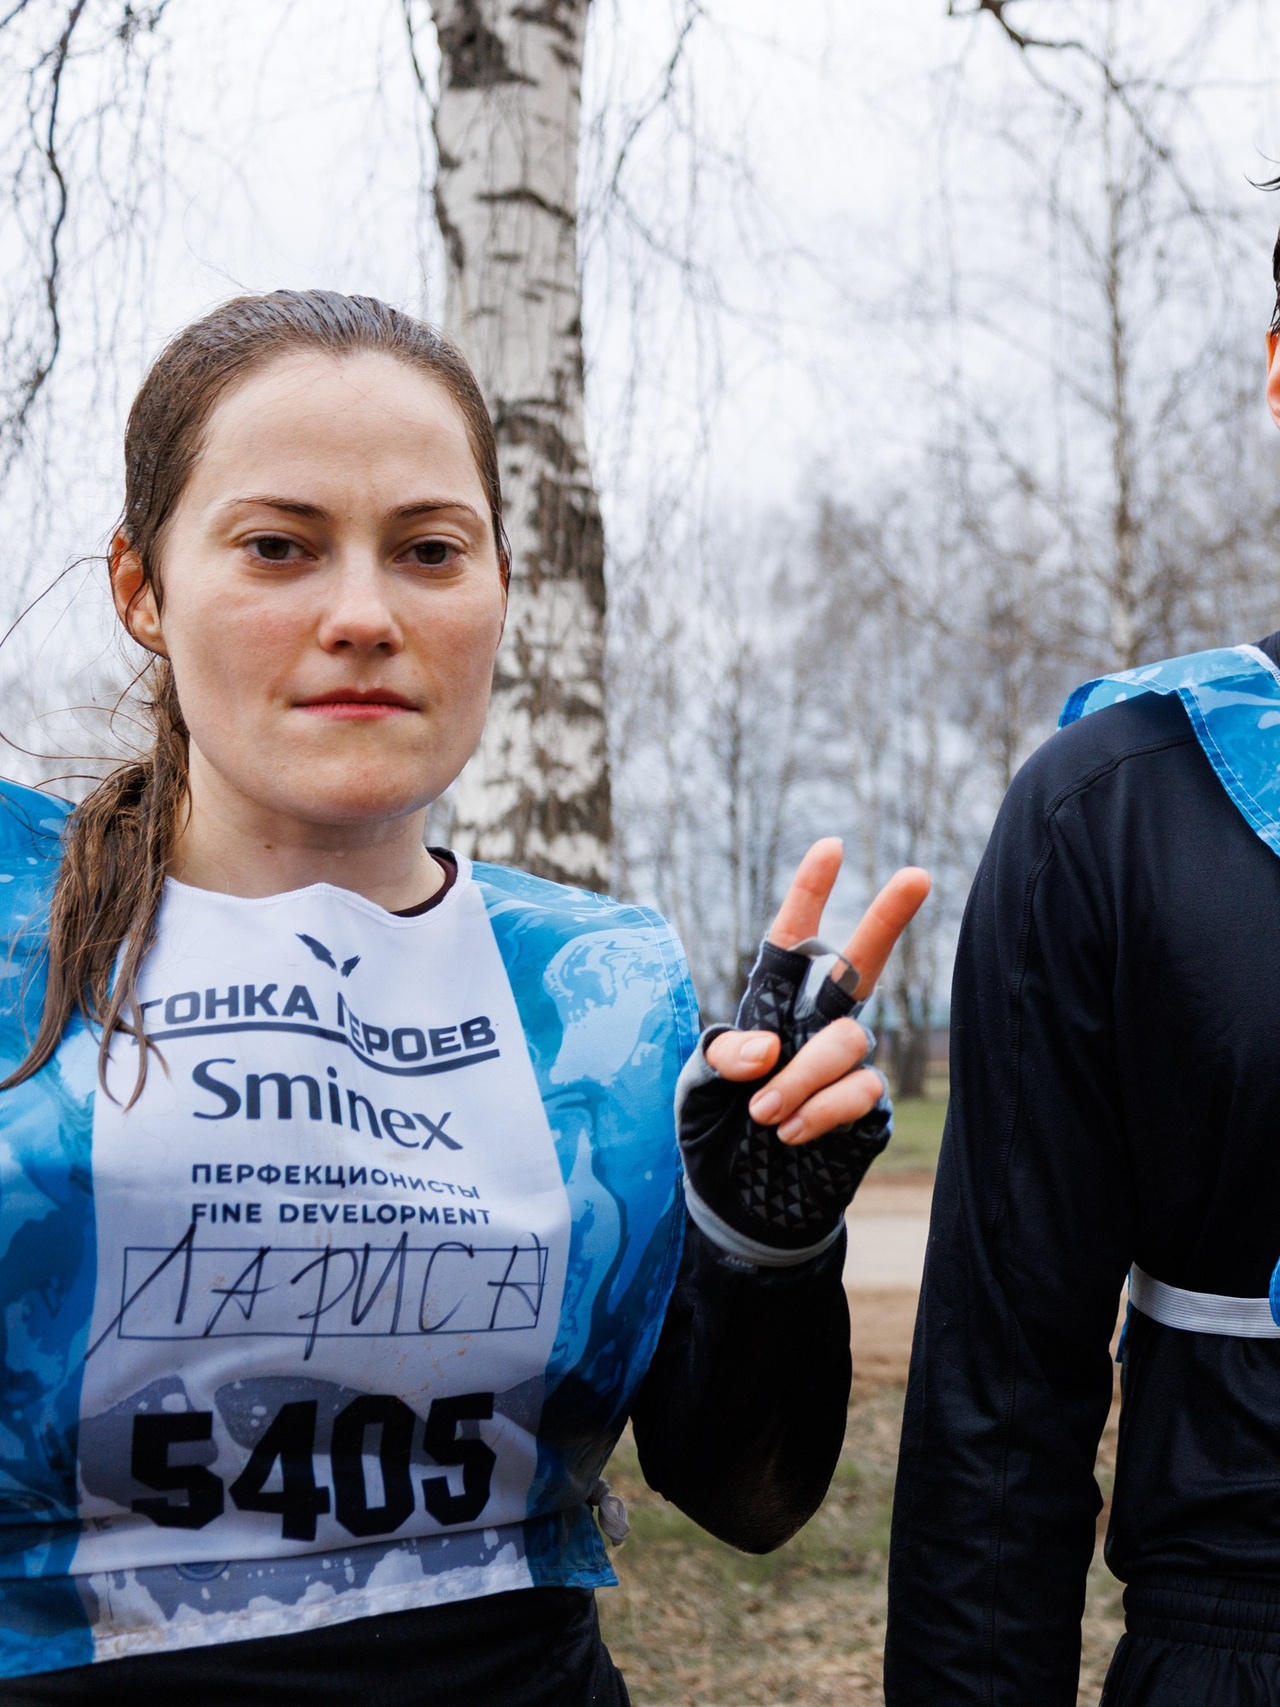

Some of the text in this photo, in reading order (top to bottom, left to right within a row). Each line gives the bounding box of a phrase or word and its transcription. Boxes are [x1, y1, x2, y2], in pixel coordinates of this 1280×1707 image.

[139, 983, 497, 1063] ГОНКА ГЕРОЕВ
[192, 1057, 464, 1151] Sminex
[192, 1163, 481, 1199] ПЕРФЕКЦИОНИСТЫ
[192, 1203, 490, 1225] FINE DEVELOPMENT
[131, 1392, 497, 1541] 5405
